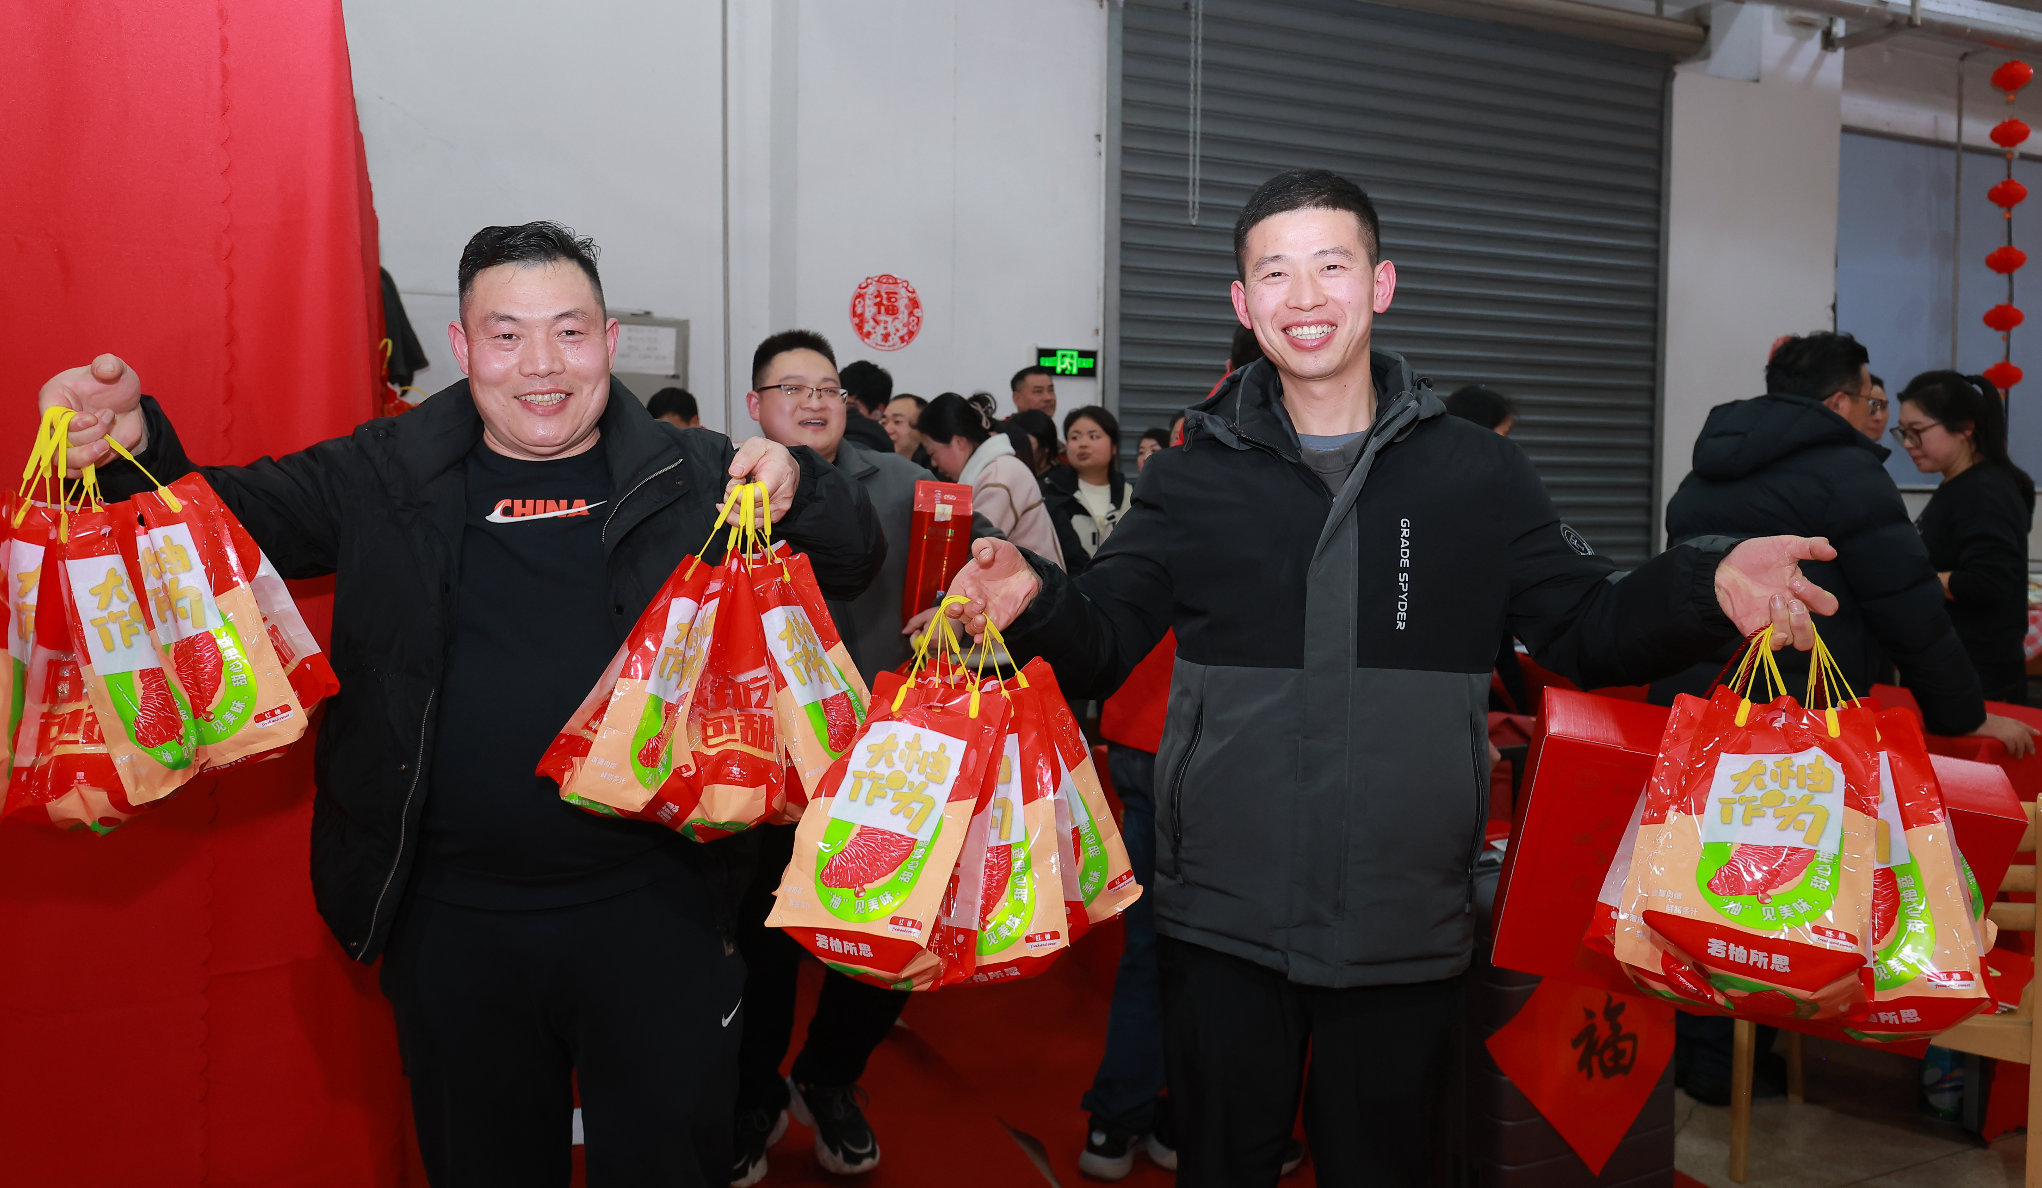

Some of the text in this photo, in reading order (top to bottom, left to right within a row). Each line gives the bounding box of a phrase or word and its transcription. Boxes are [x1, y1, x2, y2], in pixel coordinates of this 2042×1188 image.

[493, 499, 591, 518] CHINA
[1396, 518, 1411, 631] GRADE SPYDER
[815, 933, 874, 958] 若柚所思
[1707, 938, 1791, 973] 若柚所思
[966, 966, 1021, 984] 柚所思
[1570, 992, 1638, 1081] 福
